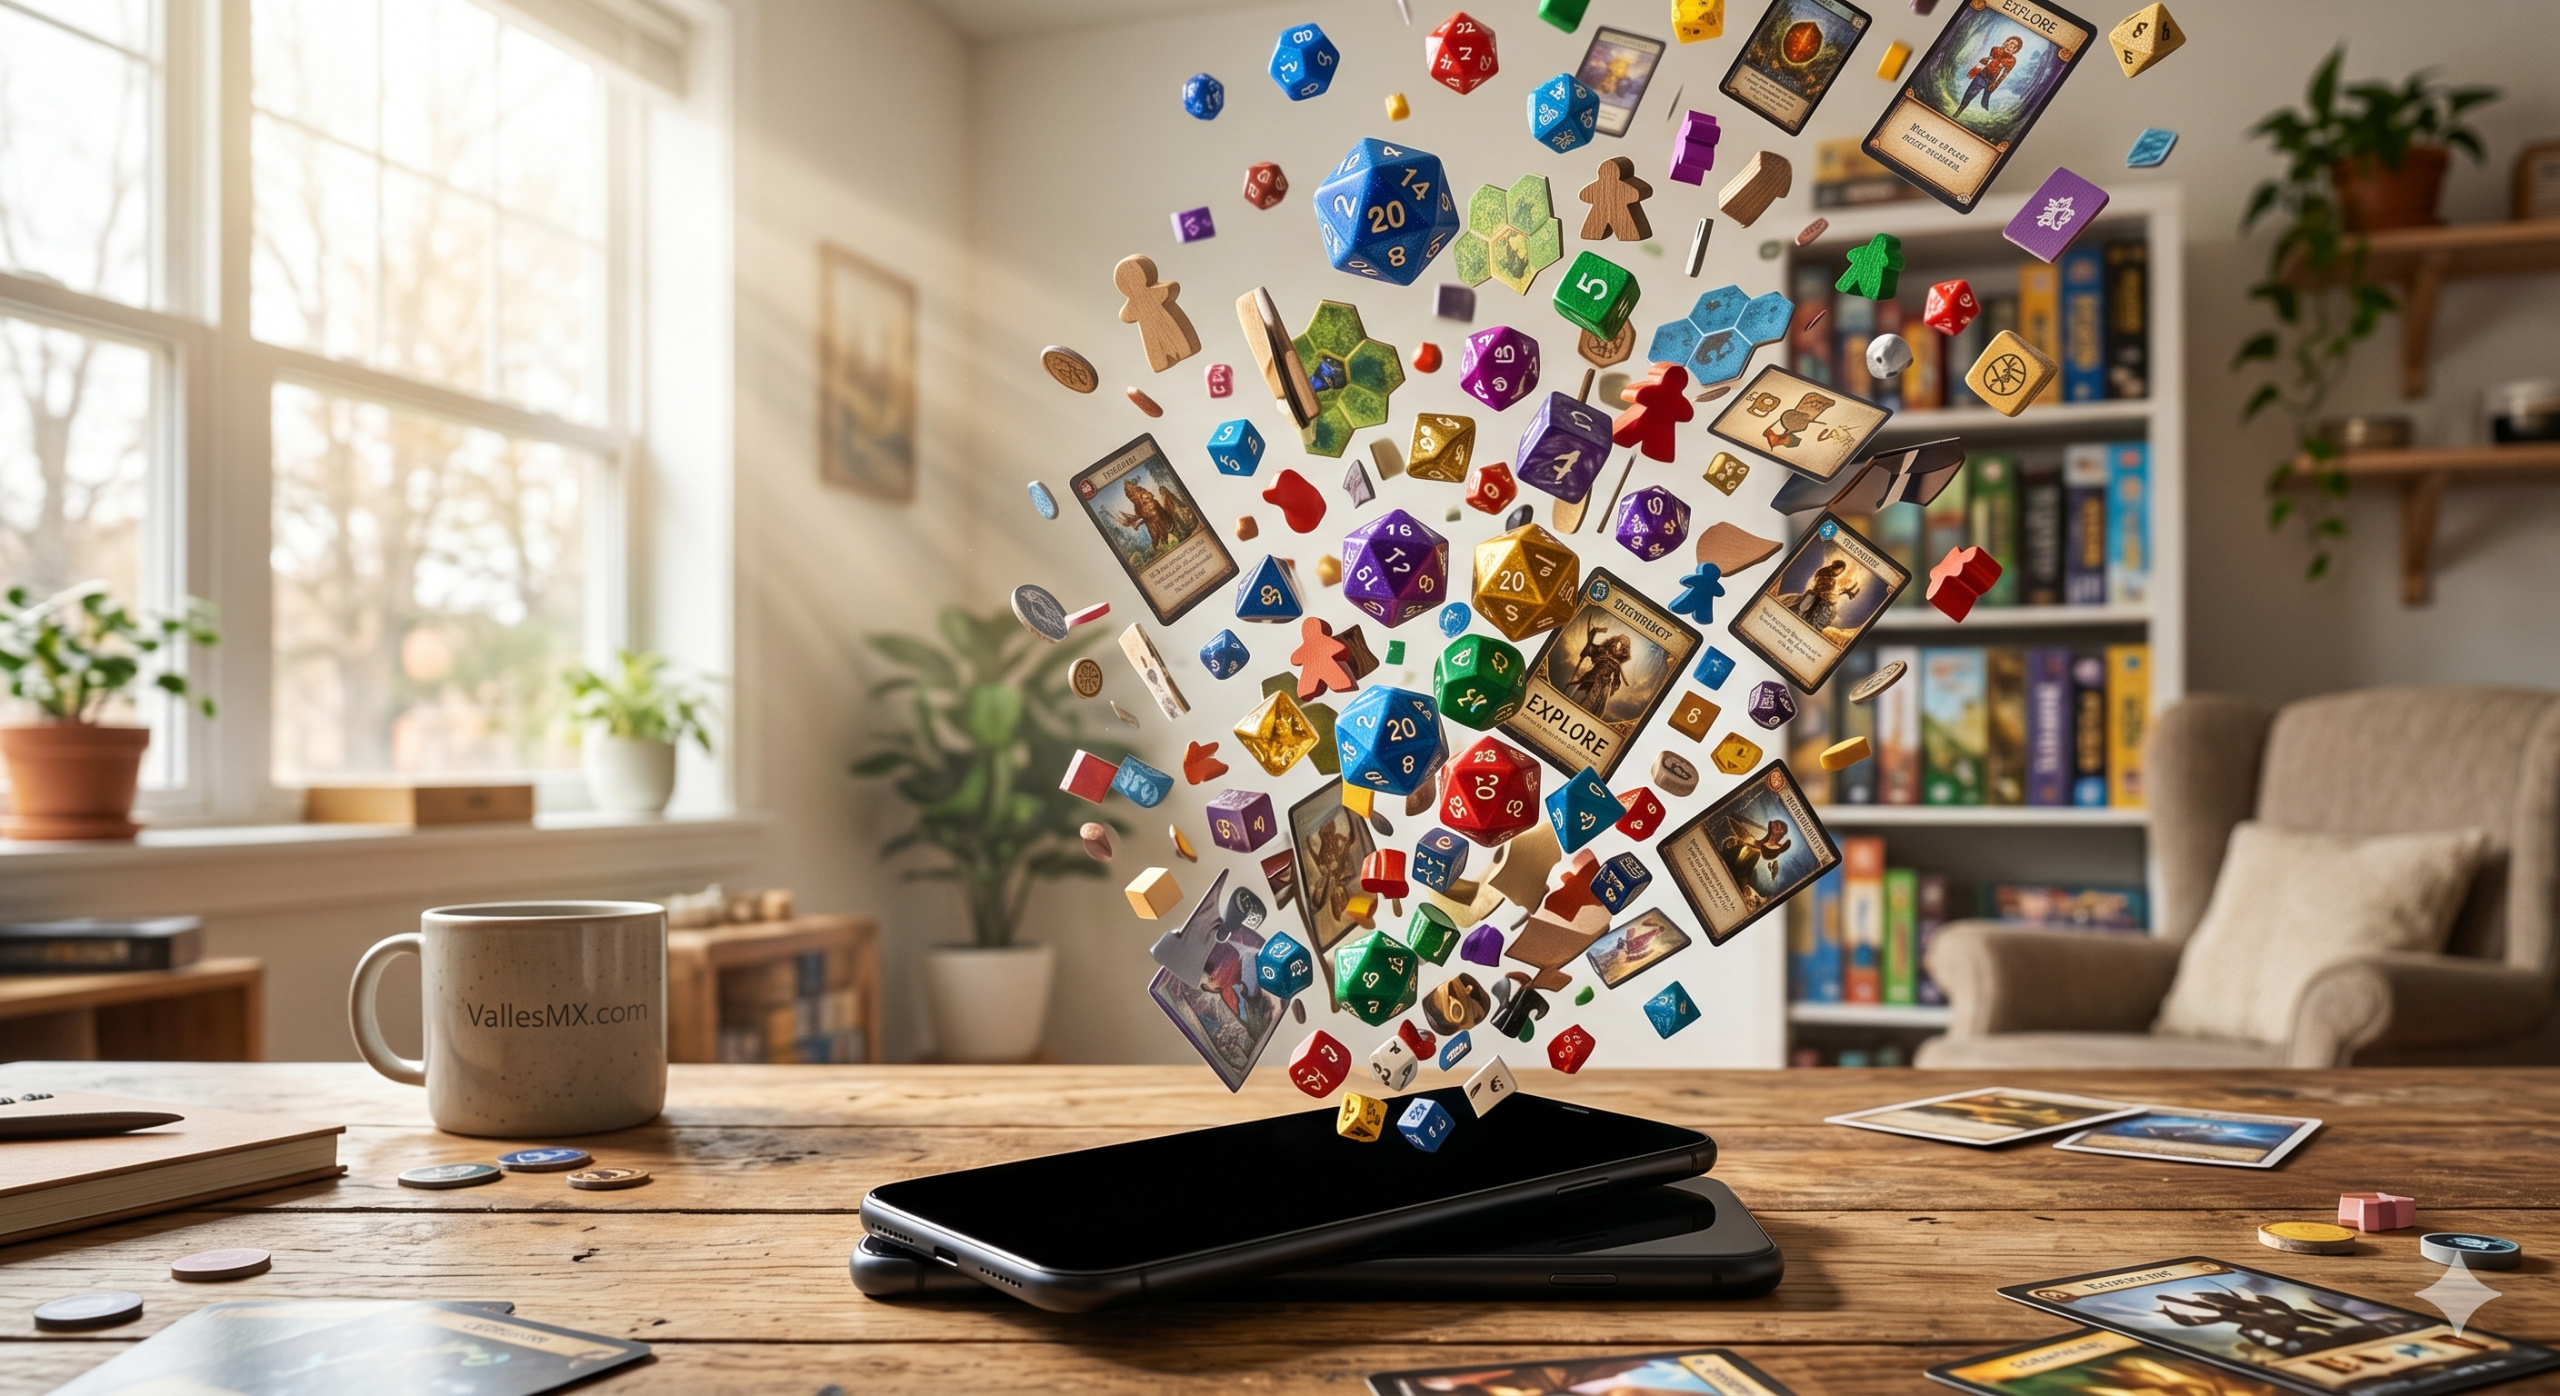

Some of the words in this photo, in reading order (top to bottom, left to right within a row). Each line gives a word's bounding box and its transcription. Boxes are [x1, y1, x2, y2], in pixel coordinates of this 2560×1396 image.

[1401, 168, 1430, 201] 14
[1333, 193, 1357, 219] 2
[1368, 200, 1406, 234] 20
[1388, 246, 1406, 267] 8
[1576, 272, 1608, 301] 5
[1385, 523, 1413, 537] 16
[1419, 574, 1434, 593] 8
[1499, 570, 1525, 592] 20
[1387, 717, 1417, 742] 20
[1525, 693, 1610, 757] EXPLORE
[1402, 755, 1415, 774] 8
[467, 1003, 648, 1028] VallesMX.com
